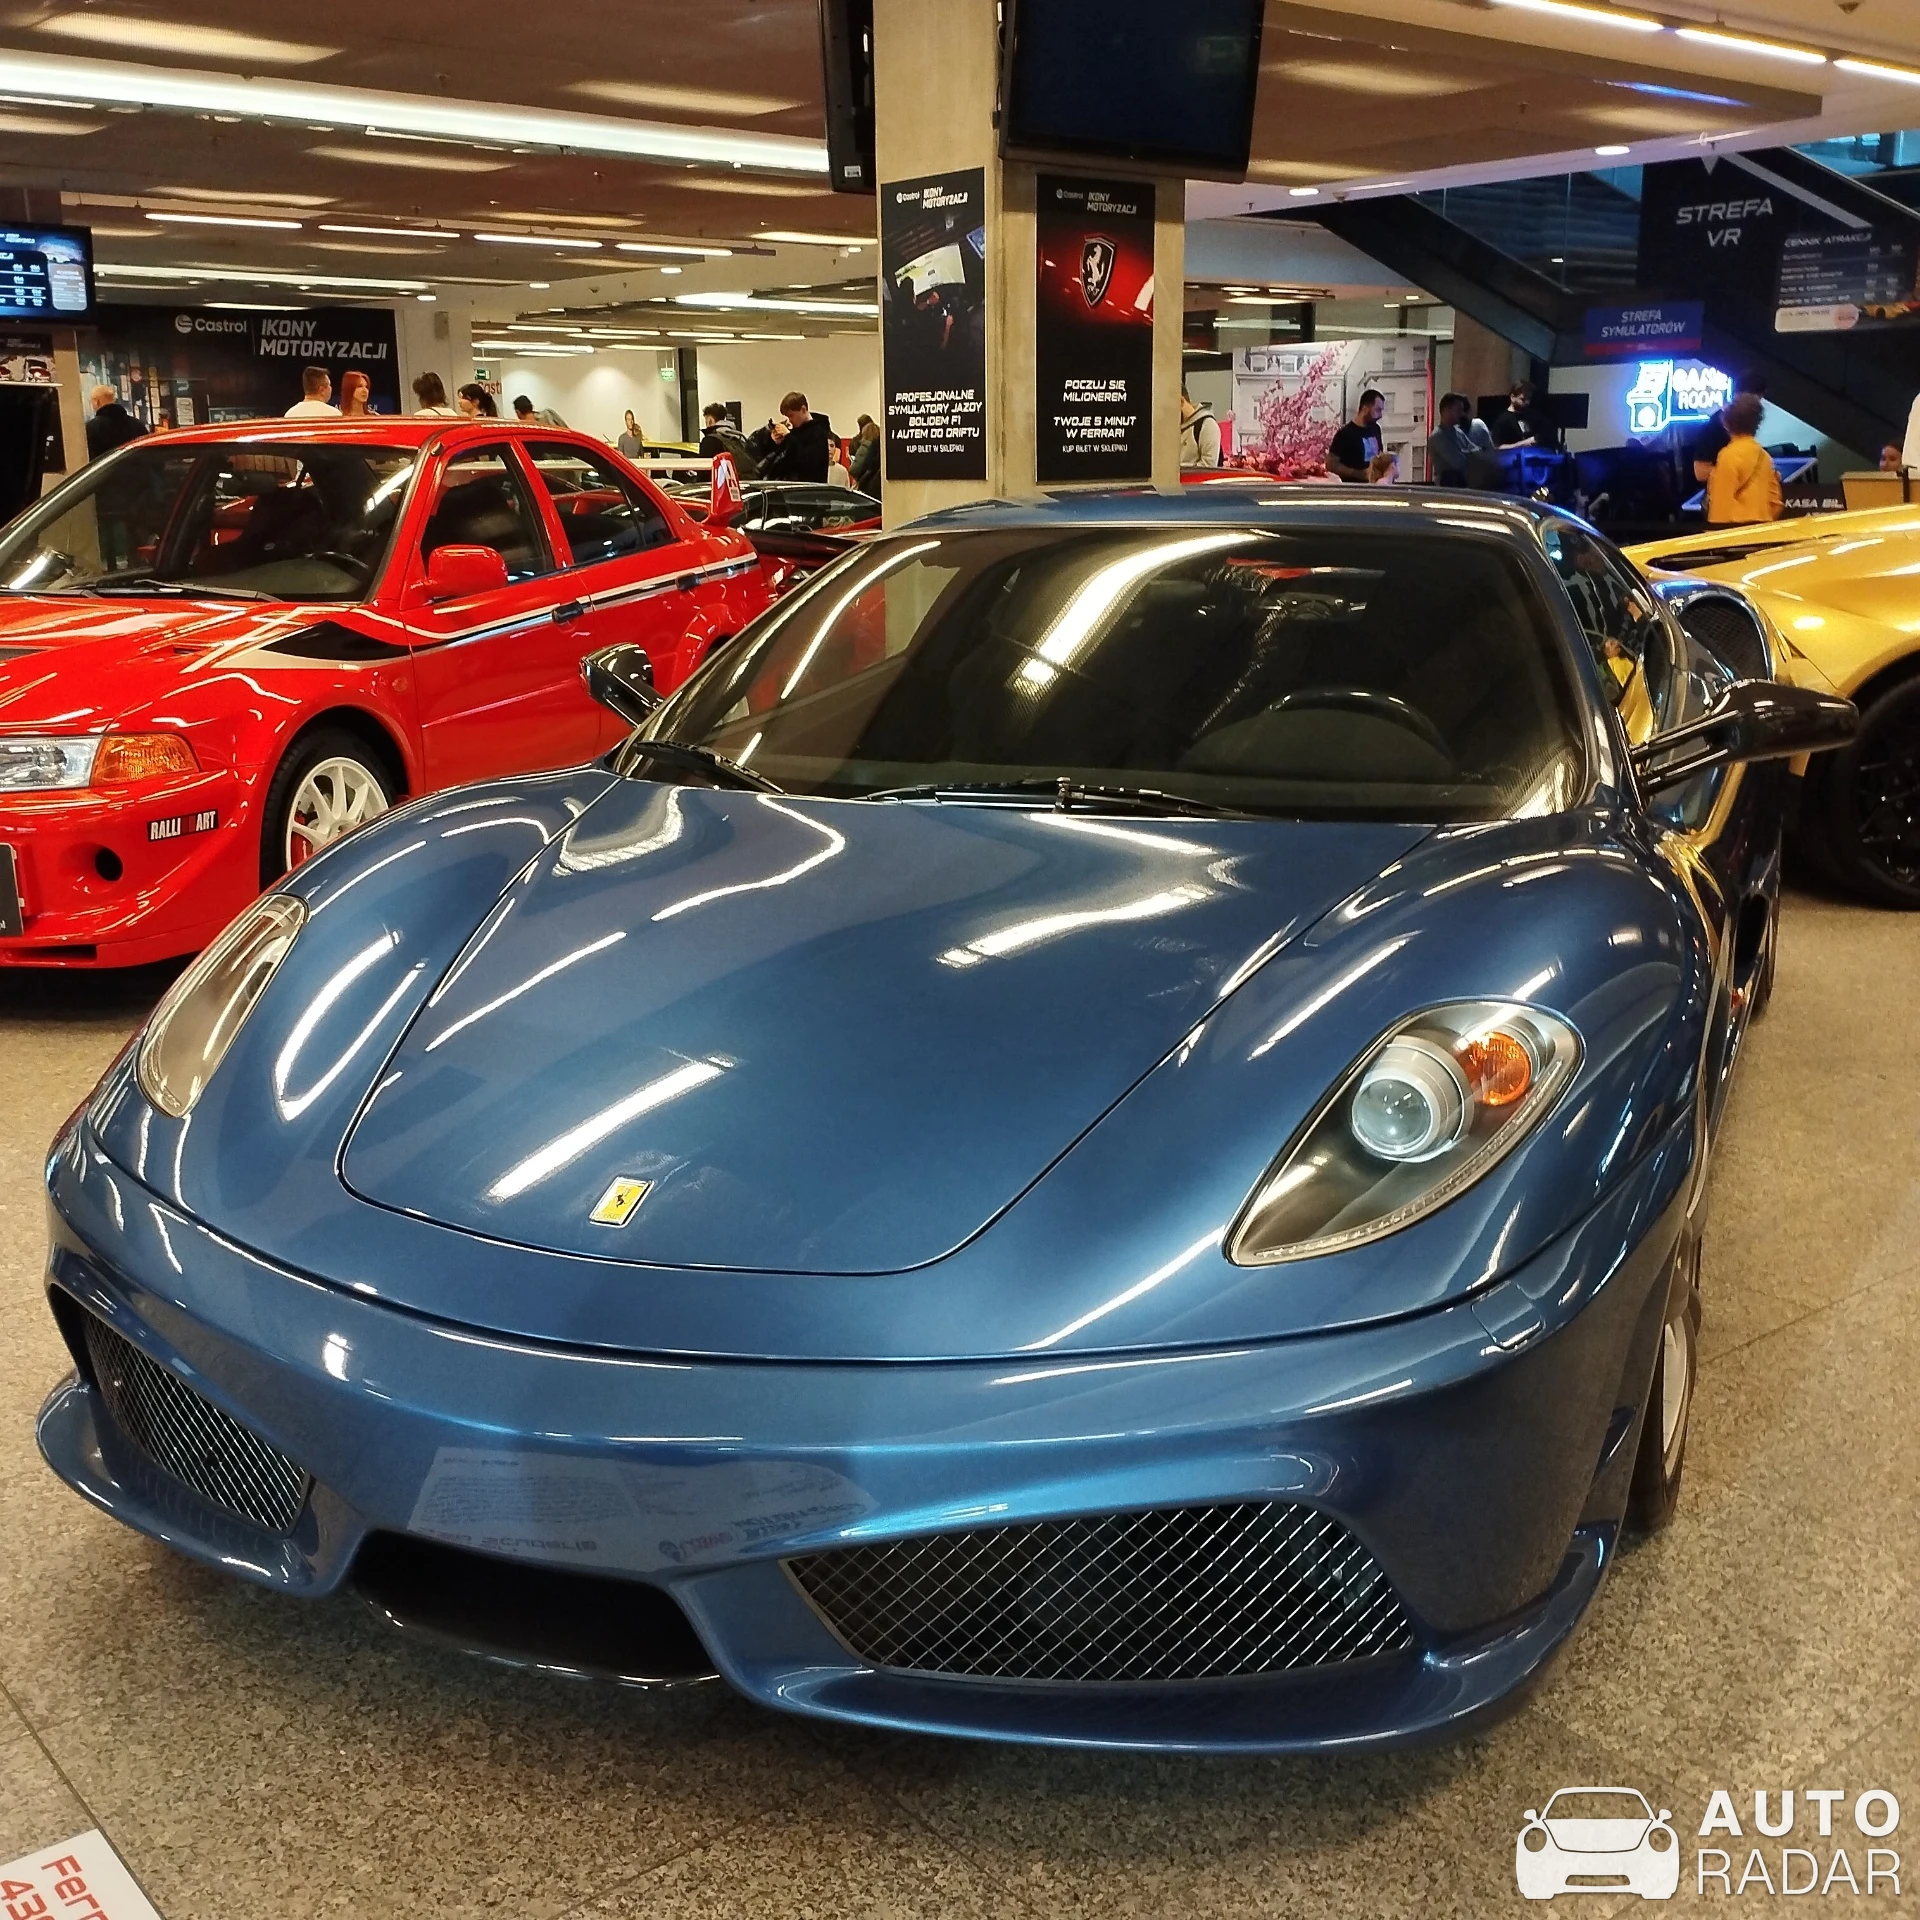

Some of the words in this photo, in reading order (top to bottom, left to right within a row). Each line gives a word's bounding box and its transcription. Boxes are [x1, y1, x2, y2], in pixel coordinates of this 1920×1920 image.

[923, 186, 943, 199] IKONY
[1088, 191, 1110, 202] IKONY
[922, 191, 968, 209] MOTORYZACJI
[1087, 202, 1137, 214] MOTORYZACJI
[1675, 197, 1773, 225] STREFA
[1707, 228, 1742, 247] VR
[1620, 309, 1662, 324] STREFA
[195, 317, 247, 333] Castrol
[261, 318, 317, 337] IKONY
[1600, 320, 1686, 338] SYMULATORÓW
[260, 338, 387, 360] MOTORYZACJI
[1065, 380, 1106, 390] POCZUJ
[1108, 380, 1126, 391] SIĘ
[895, 389, 975, 403] PROFESJONALNE
[1063, 392, 1127, 402] MILIONEREM
[1678, 390, 1724, 410] ROOM
[888, 403, 949, 416] SYMULATORY
[951, 401, 983, 413] JAZDY
[908, 415, 949, 427] BOLIDEM
[951, 414, 961, 425] F1
[1053, 416, 1092, 426] TWOJE
[1094, 416, 1102, 426] 5
[1104, 416, 1137, 426] MINUT
[896, 428, 928, 439] AUTEM
[930, 428, 944, 438] DO
[945, 427, 980, 438] DRIFTU
[1065, 428, 1078, 438] W
[1080, 428, 1125, 438] FERRARI
[906, 444, 917, 453] KUP
[917, 444, 932, 453] BILET
[932, 444, 939, 452] W
[1062, 444, 1075, 453] KUP
[1075, 444, 1092, 453] BILET
[1093, 444, 1100, 452] W
[1784, 498, 1818, 508] KASA
[150, 817, 181, 840] RALLI
[195, 810, 216, 832] ART
[0, 1880, 55, 1920] 43
